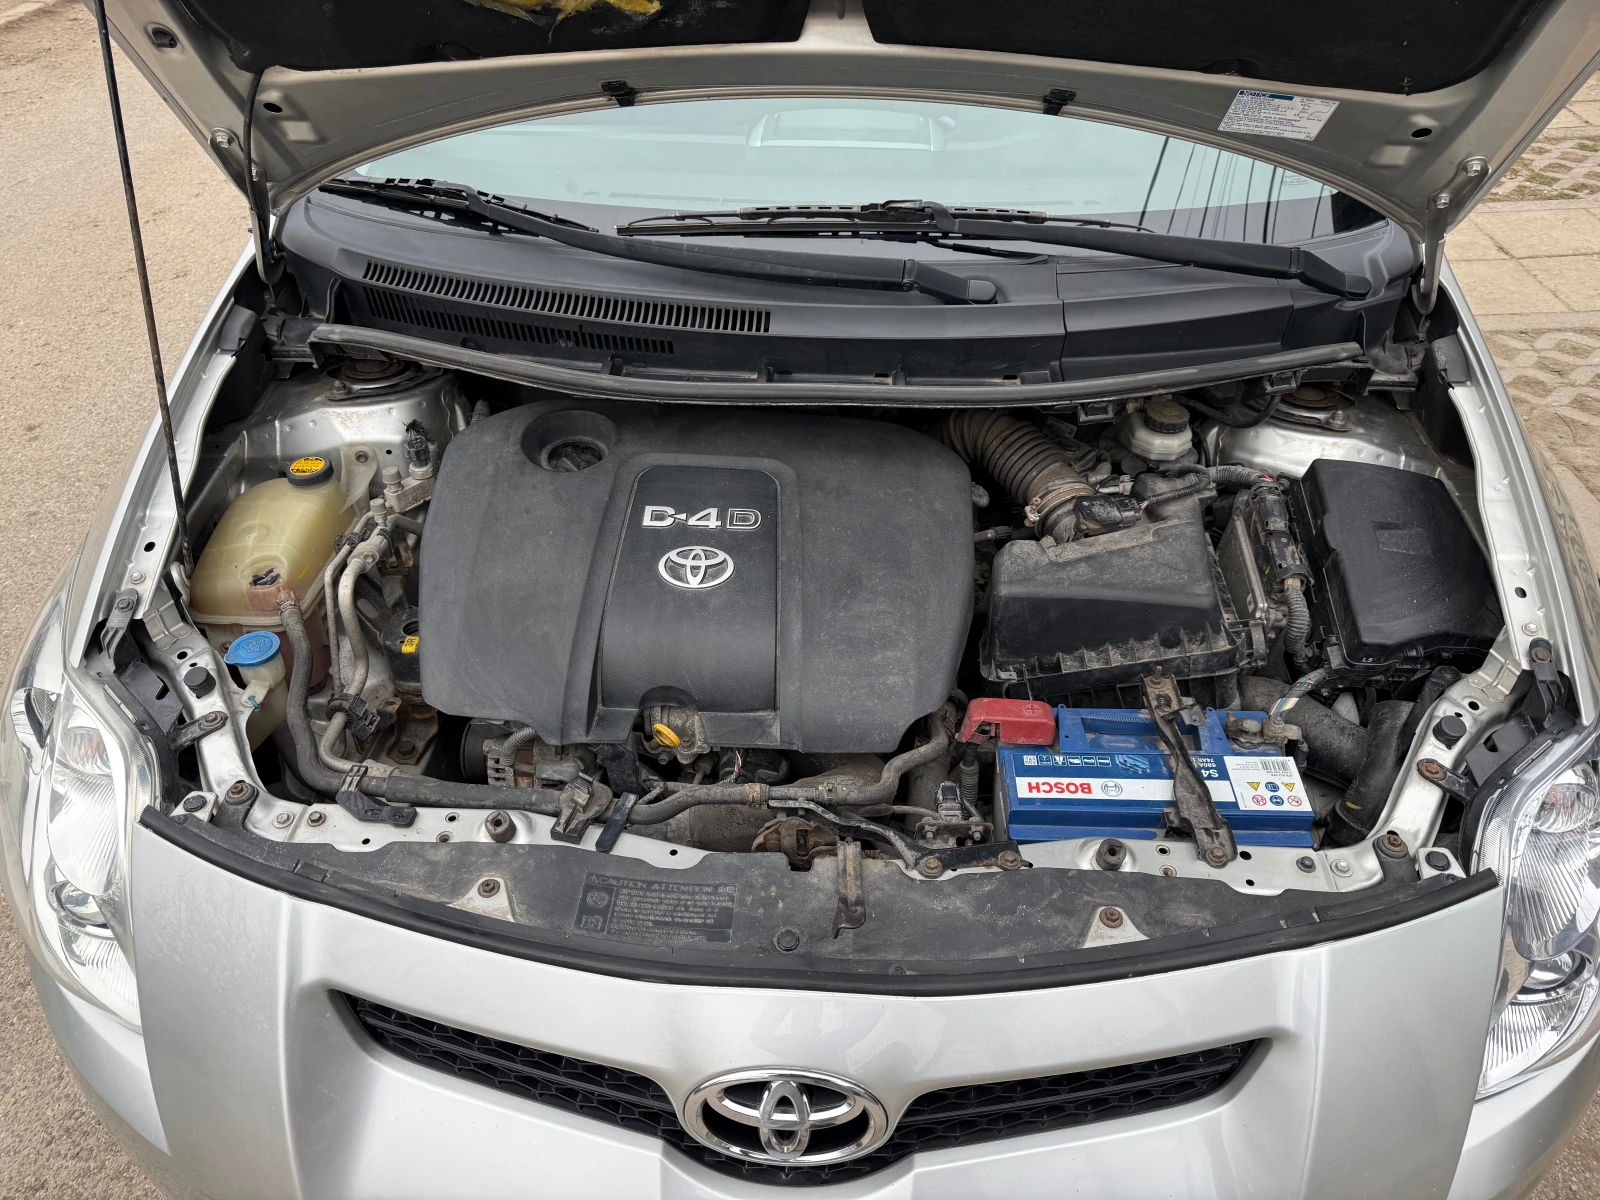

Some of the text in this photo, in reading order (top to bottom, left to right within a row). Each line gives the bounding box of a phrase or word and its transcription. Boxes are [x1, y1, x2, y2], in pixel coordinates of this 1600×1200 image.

[642, 505, 762, 531] D-4D
[1200, 769, 1219, 778] S4
[1027, 781, 1093, 795] BOSCH
[599, 877, 647, 889] CAUTION
